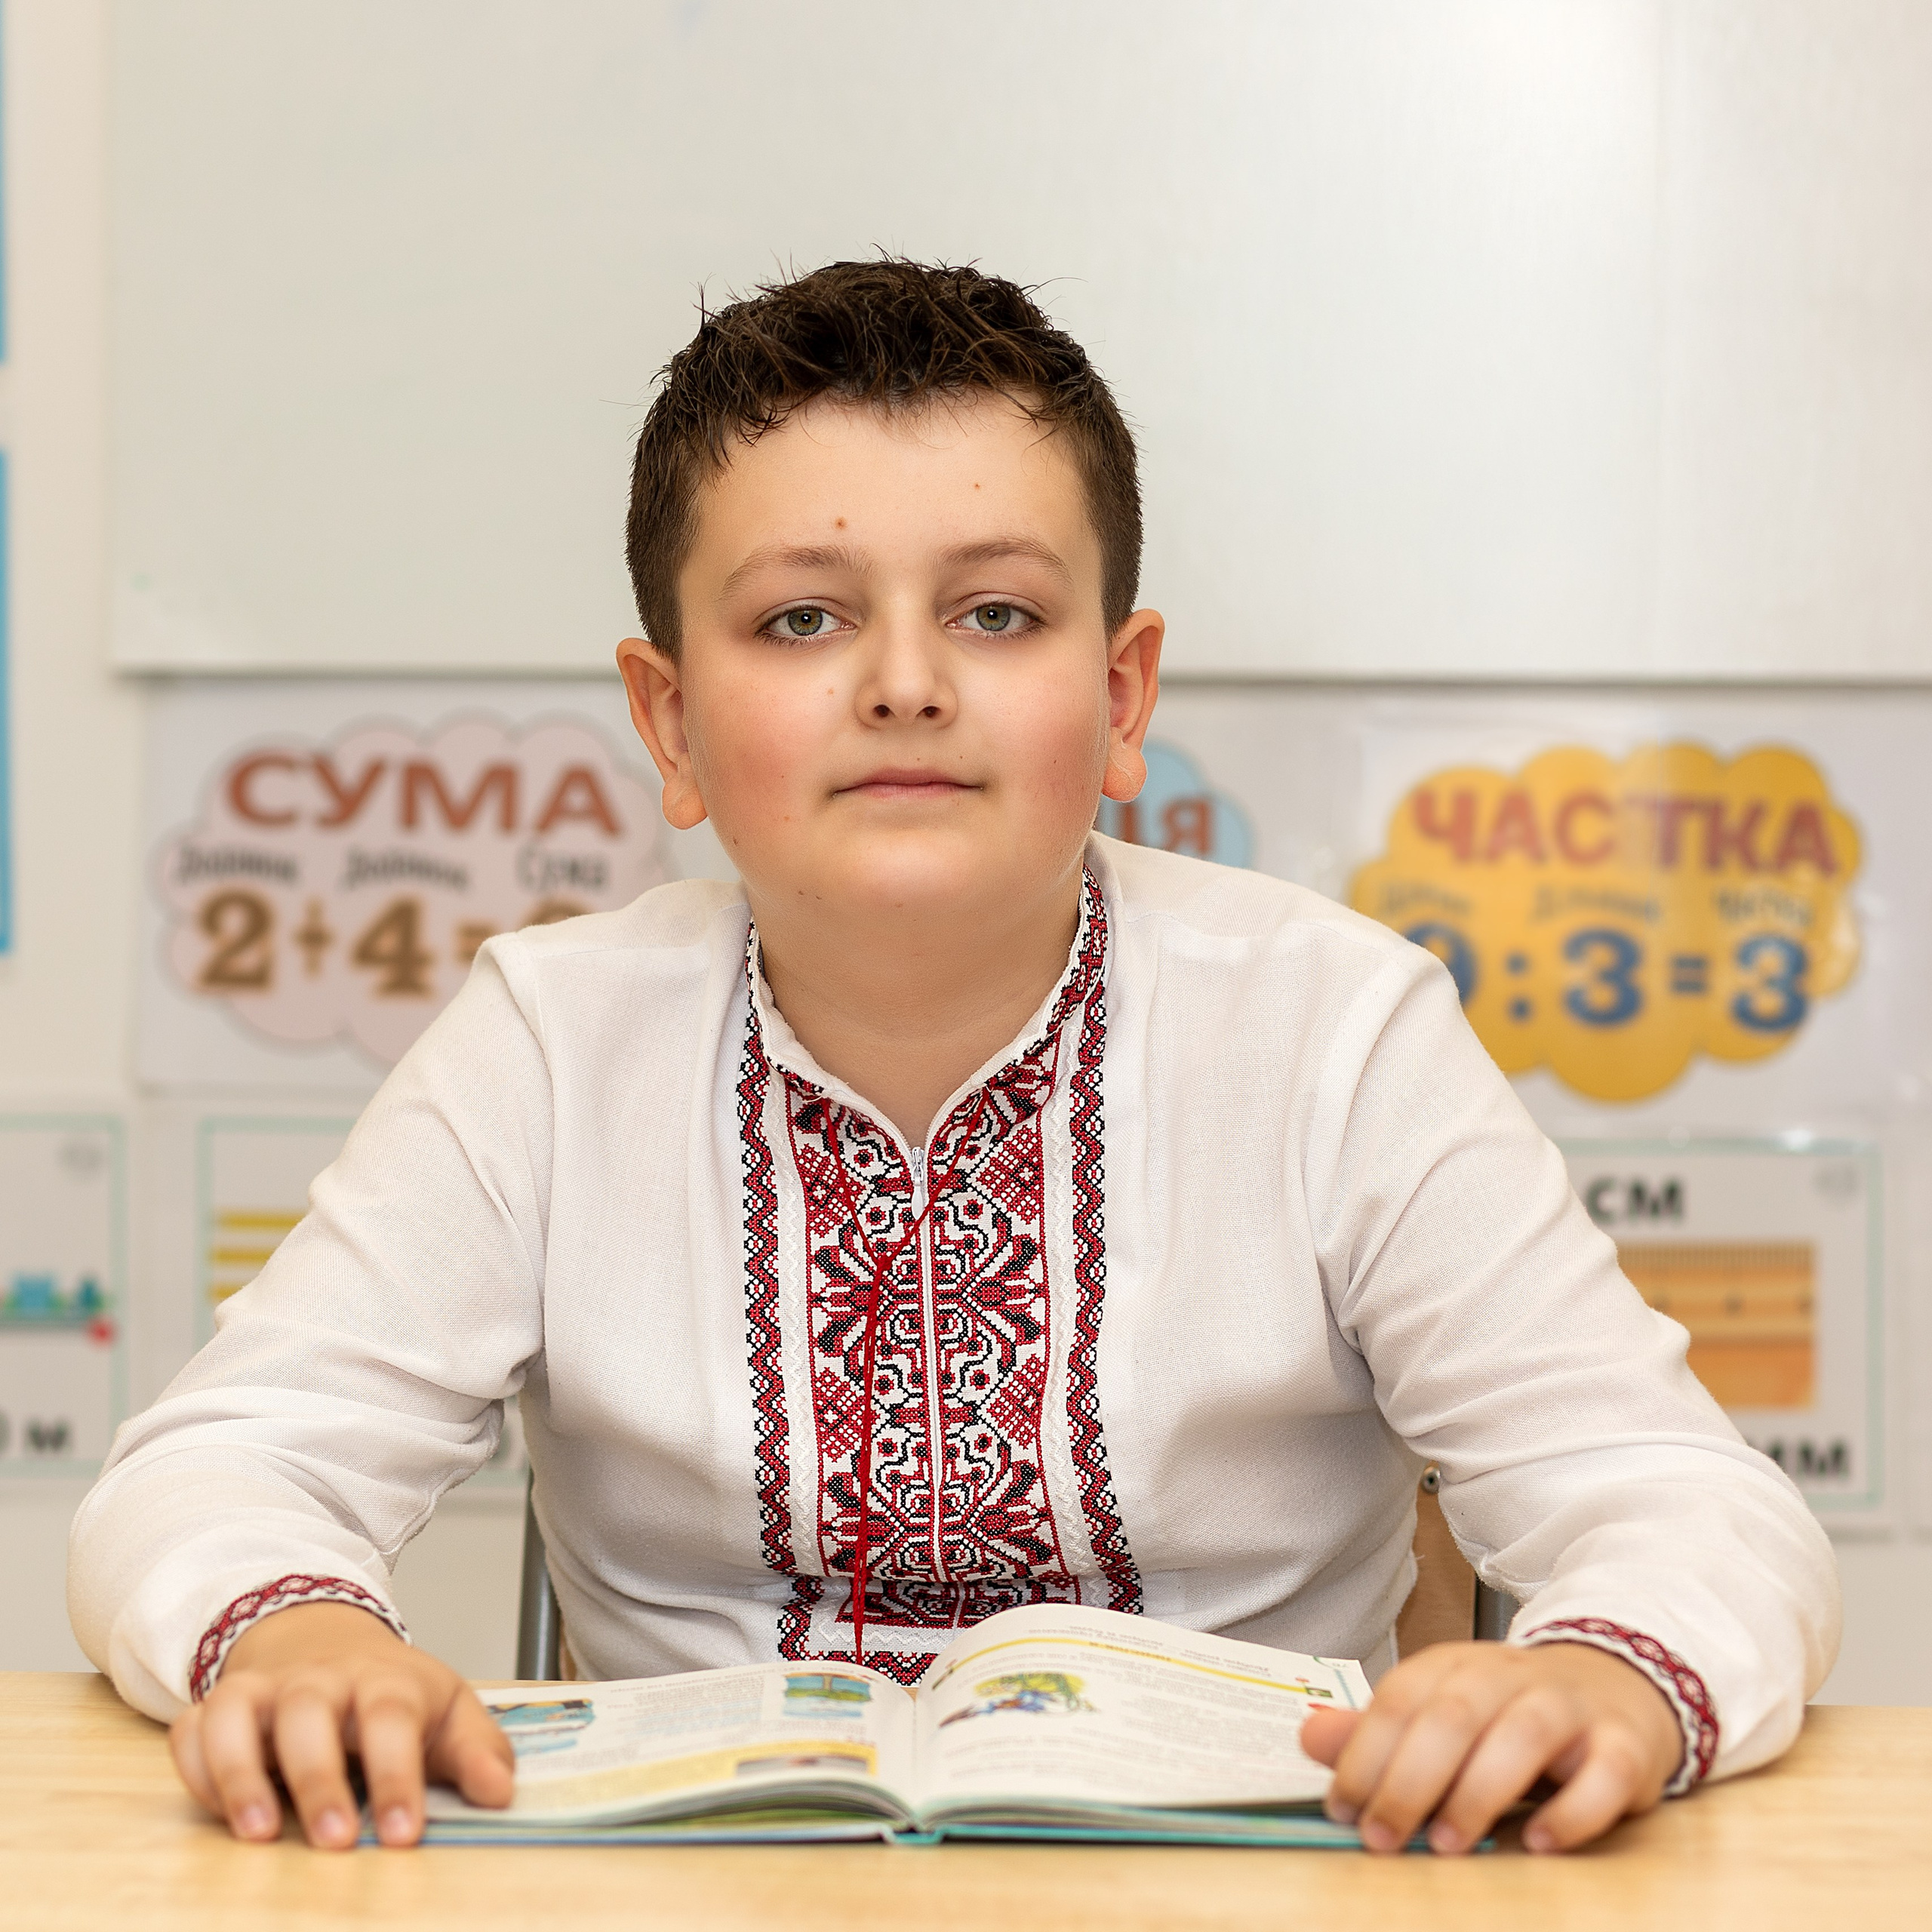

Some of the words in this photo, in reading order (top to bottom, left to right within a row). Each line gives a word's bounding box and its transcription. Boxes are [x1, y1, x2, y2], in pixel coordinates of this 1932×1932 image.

[226, 753, 625, 838] СУМА
[1411, 788, 1840, 879] ЧАСТКА
[1563, 925, 1644, 1028] 3
[1730, 933, 1810, 1034] 3
